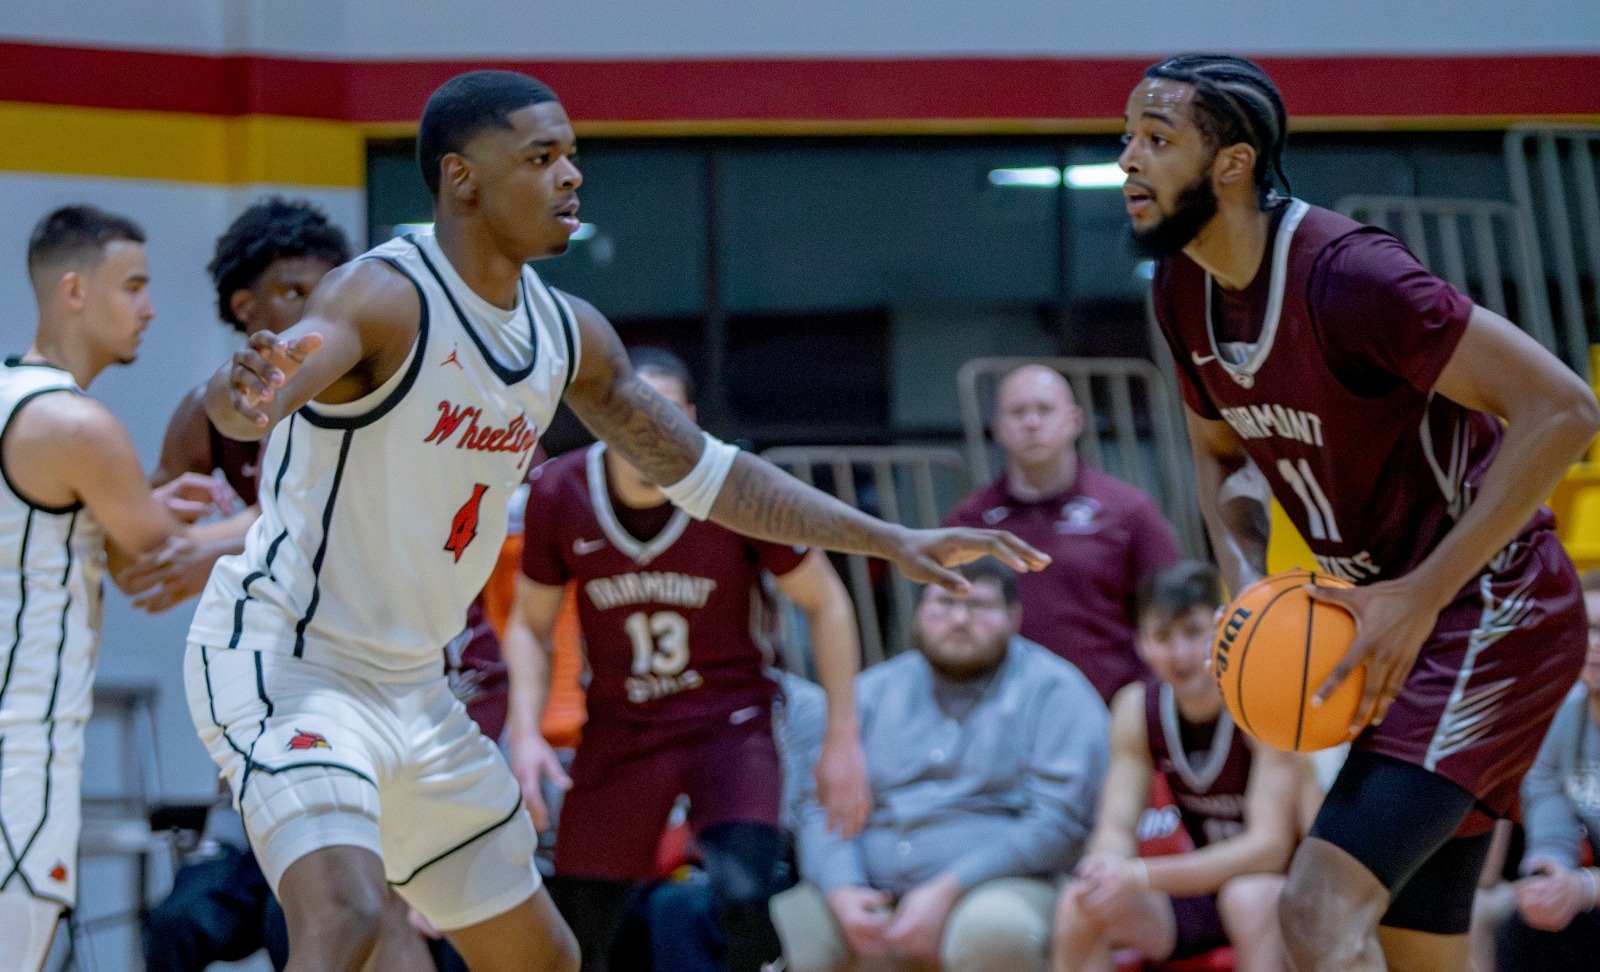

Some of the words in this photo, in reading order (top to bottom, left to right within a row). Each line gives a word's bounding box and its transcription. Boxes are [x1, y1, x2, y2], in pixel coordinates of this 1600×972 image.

[1220, 403, 1324, 447] AIRMONT
[1276, 458, 1343, 543] 11
[1313, 550, 1382, 583] TATE
[624, 610, 690, 676] 13
